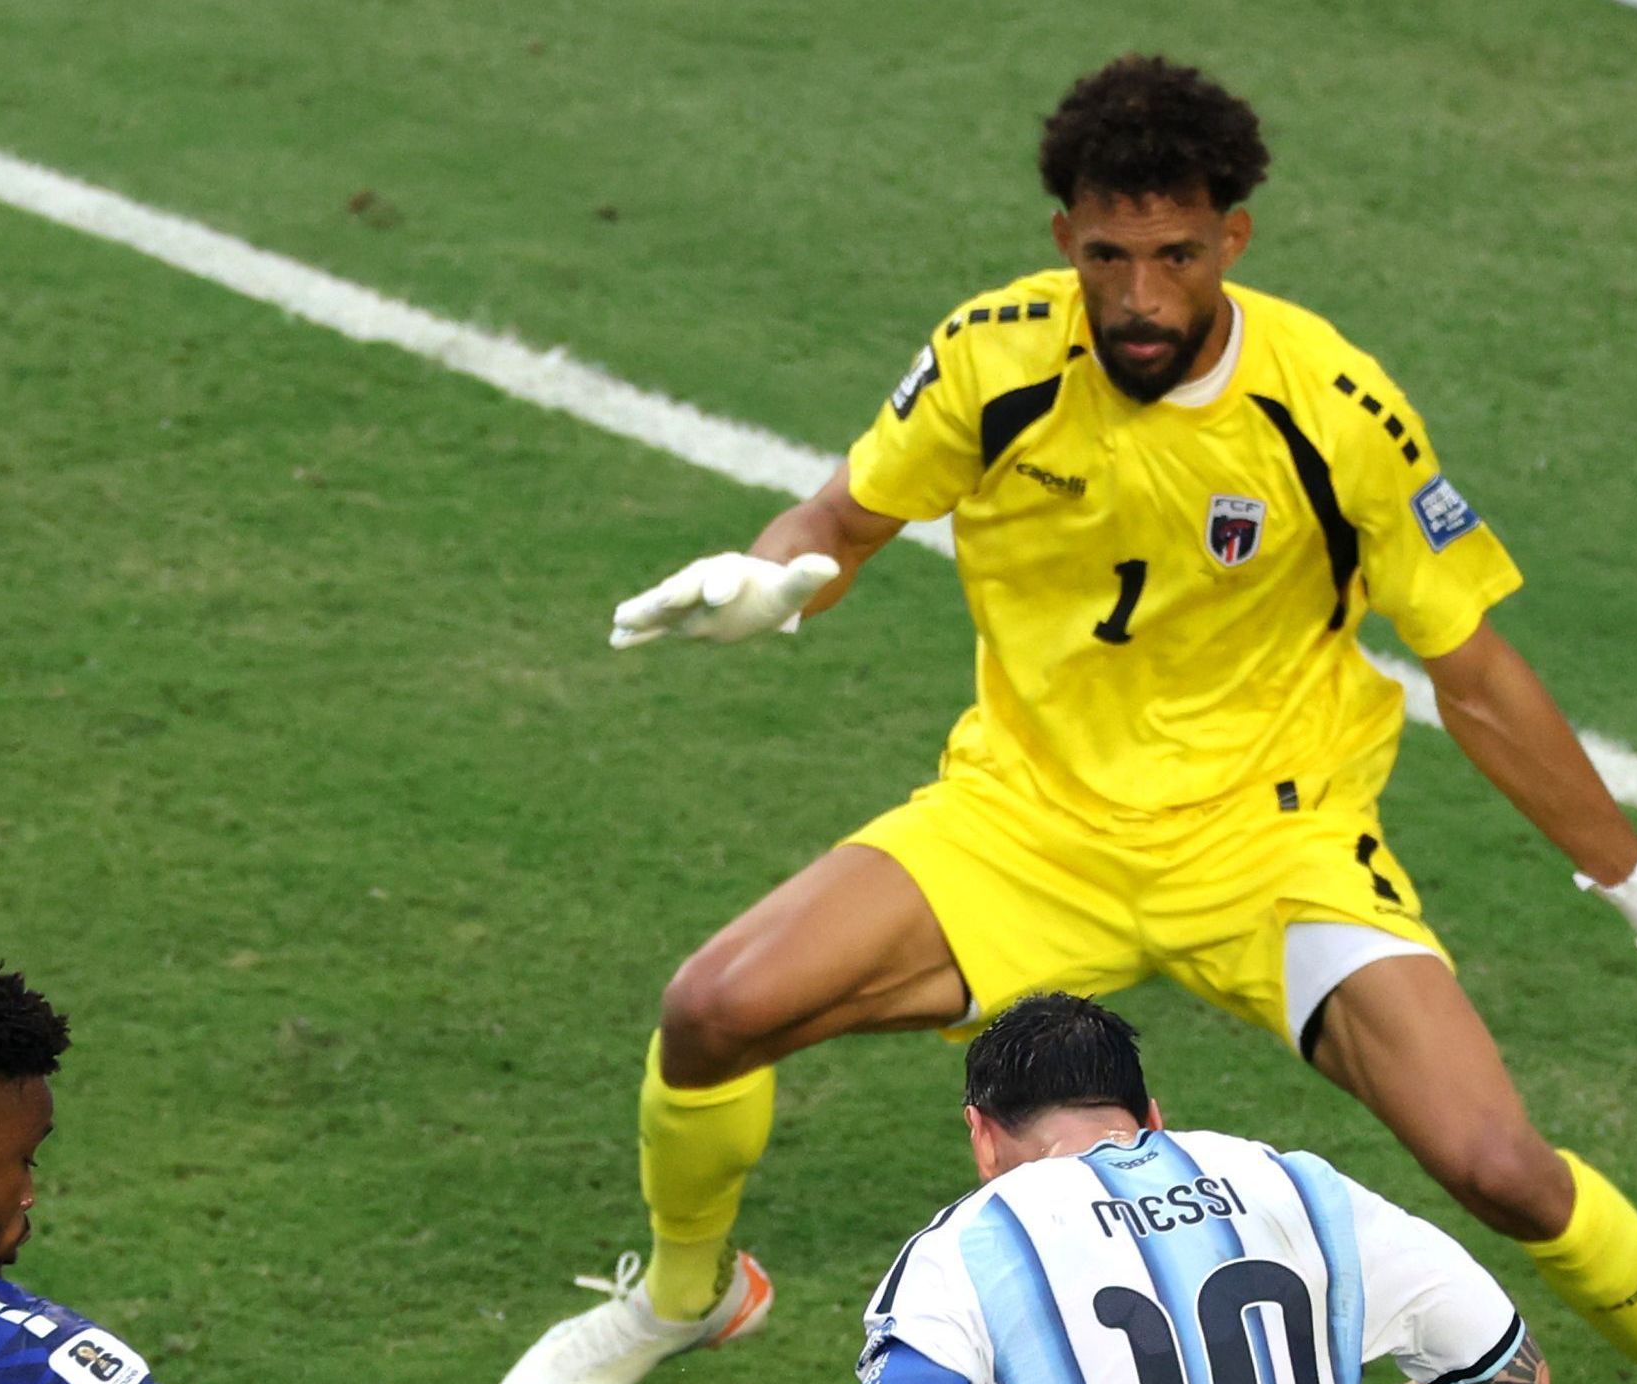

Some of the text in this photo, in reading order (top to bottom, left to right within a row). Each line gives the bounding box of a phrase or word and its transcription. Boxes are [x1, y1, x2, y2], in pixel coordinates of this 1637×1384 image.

[1215, 499, 1260, 512] FCF
[1093, 559, 1147, 645] 1
[1091, 1177, 1247, 1238] MESSI
